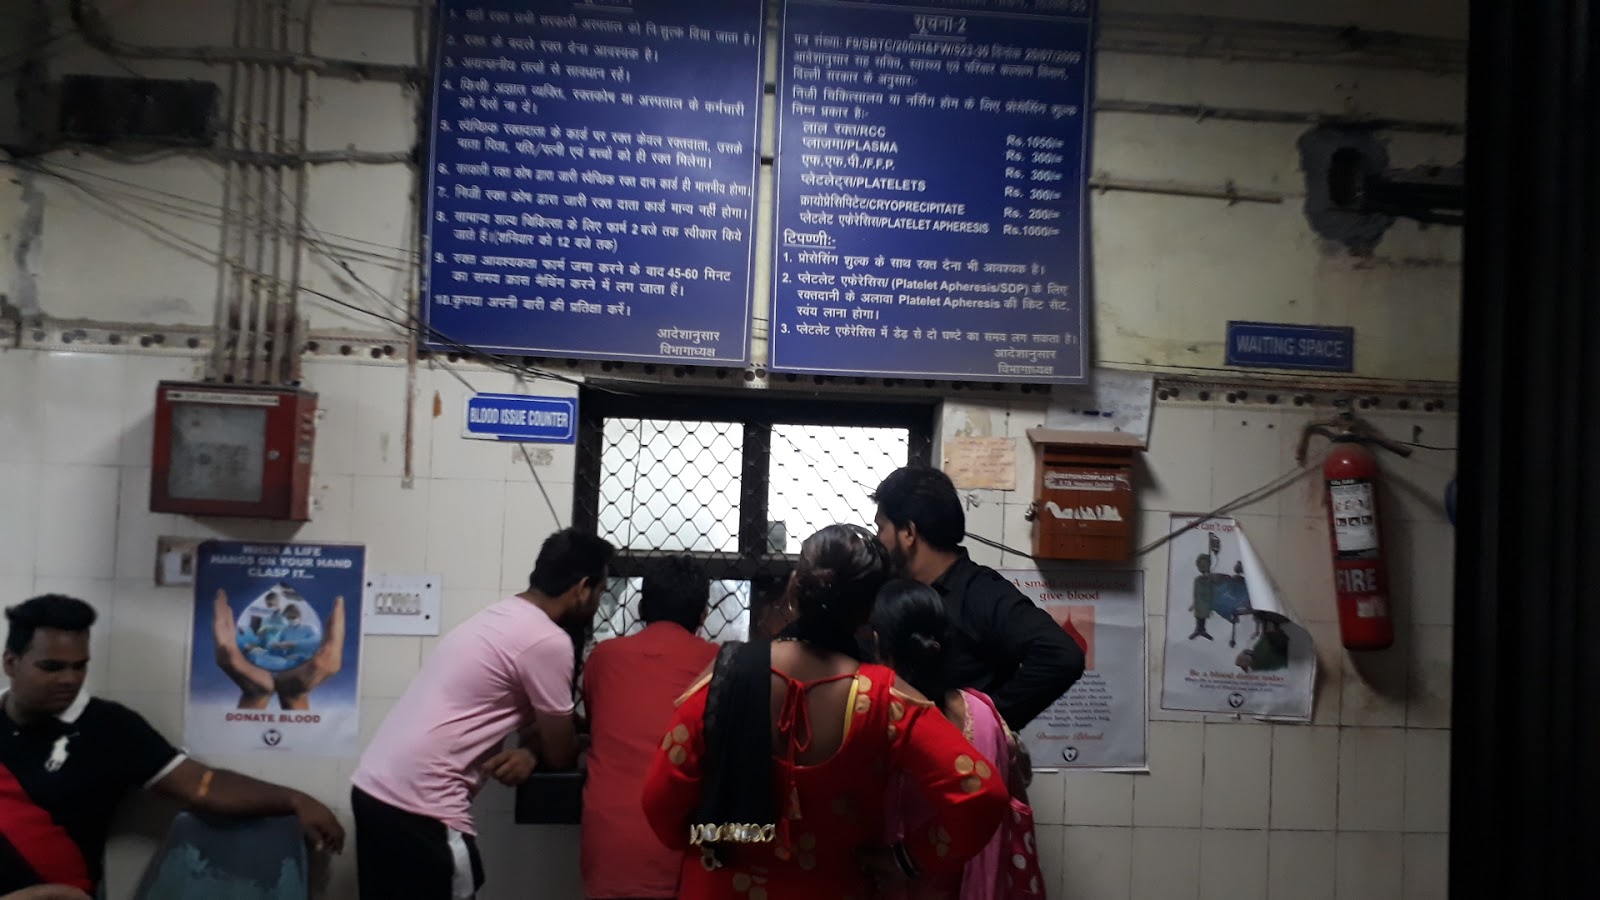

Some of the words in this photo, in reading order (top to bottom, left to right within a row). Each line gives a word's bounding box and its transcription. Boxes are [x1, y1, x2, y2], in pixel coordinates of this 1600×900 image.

[863, 71, 873, 84] के
[803, 121, 827, 134] लाल
[799, 209, 833, 224] प्लेटलेट
[932, 220, 989, 233] APHERESIS
[783, 251, 792, 262] 1.
[798, 250, 838, 264] प्रोसेसिंग
[843, 255, 869, 269] शुल्क
[874, 254, 885, 267] के
[890, 257, 911, 268] साथ
[942, 258, 961, 271] देना
[966, 258, 978, 272] भी
[598, 261, 624, 274] करने
[629, 261, 640, 275] के
[667, 267, 698, 279] 45-60
[704, 266, 731, 281] मिनट
[615, 281, 634, 292] लग
[639, 283, 665, 294] जाता
[781, 272, 792, 283] 2.
[797, 271, 835, 285] प्लेटलेट
[891, 277, 937, 290] (Platelet
[844, 289, 855, 302] के
[860, 293, 893, 304] अलावा
[898, 294, 940, 306] Platelet
[943, 297, 1000, 308] Apheresis
[1003, 296, 1017, 308] की
[822, 307, 847, 318] लाना
[852, 306, 879, 320] होगा।
[657, 327, 719, 343] आदेशानुसार
[780, 322, 790, 334] 3.
[796, 321, 830, 335] प्लेटलेट
[835, 324, 875, 337] एफेरेसिस
[880, 325, 888, 338] में
[912, 326, 922, 339] से
[926, 327, 937, 340] दो
[966, 331, 979, 341] का
[984, 332, 1006, 341] समय
[1011, 333, 1027, 342] लग
[659, 341, 715, 356] विभागाध्यक्ष
[1236, 335, 1296, 355] WAITING
[1298, 339, 1345, 358] SPACE
[994, 347, 1055, 362] आदेशानुसार
[470, 407, 499, 424] BLOOD
[500, 409, 527, 425] ISSUE
[528, 410, 569, 427] COUNTER
[282, 546, 292, 556] A
[295, 547, 322, 557] LIFE
[210, 555, 255, 565] HANGS
[257, 556, 276, 566] ON
[280, 557, 314, 568] YOUR
[316, 559, 352, 569] HAND
[247, 568, 290, 578] CLASP
[1335, 568, 1378, 592] FIRE
[1039, 591, 1063, 602] give
[1067, 590, 1101, 601] blood
[225, 712, 275, 723] DONATE
[278, 714, 321, 723] BLOOD
